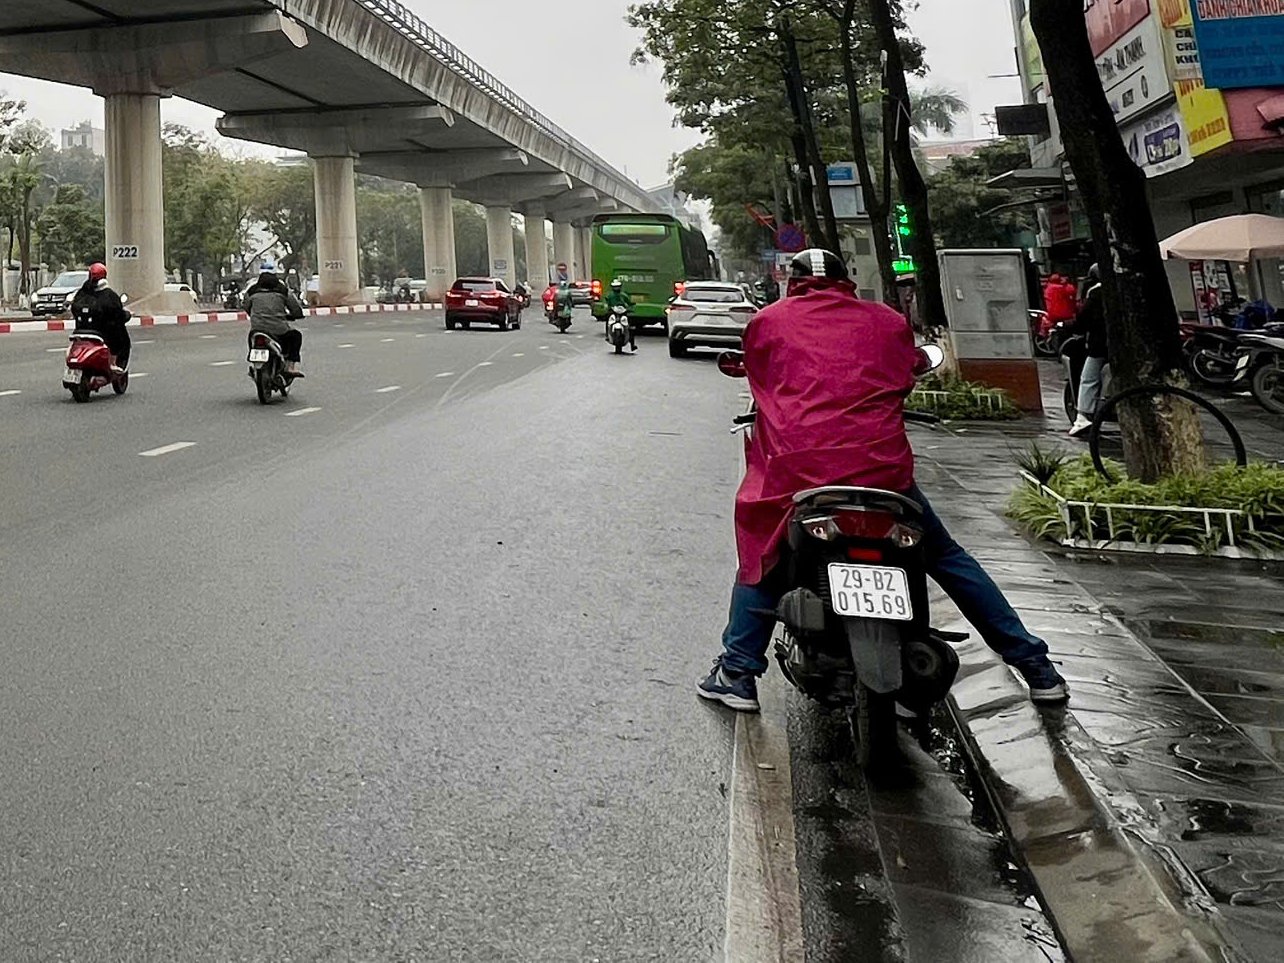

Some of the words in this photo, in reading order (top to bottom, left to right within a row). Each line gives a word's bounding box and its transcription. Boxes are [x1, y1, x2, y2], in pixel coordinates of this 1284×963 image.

[113, 246, 138, 258] P222
[840, 568, 896, 591] 29-B2
[838, 591, 906, 615] 015.69
